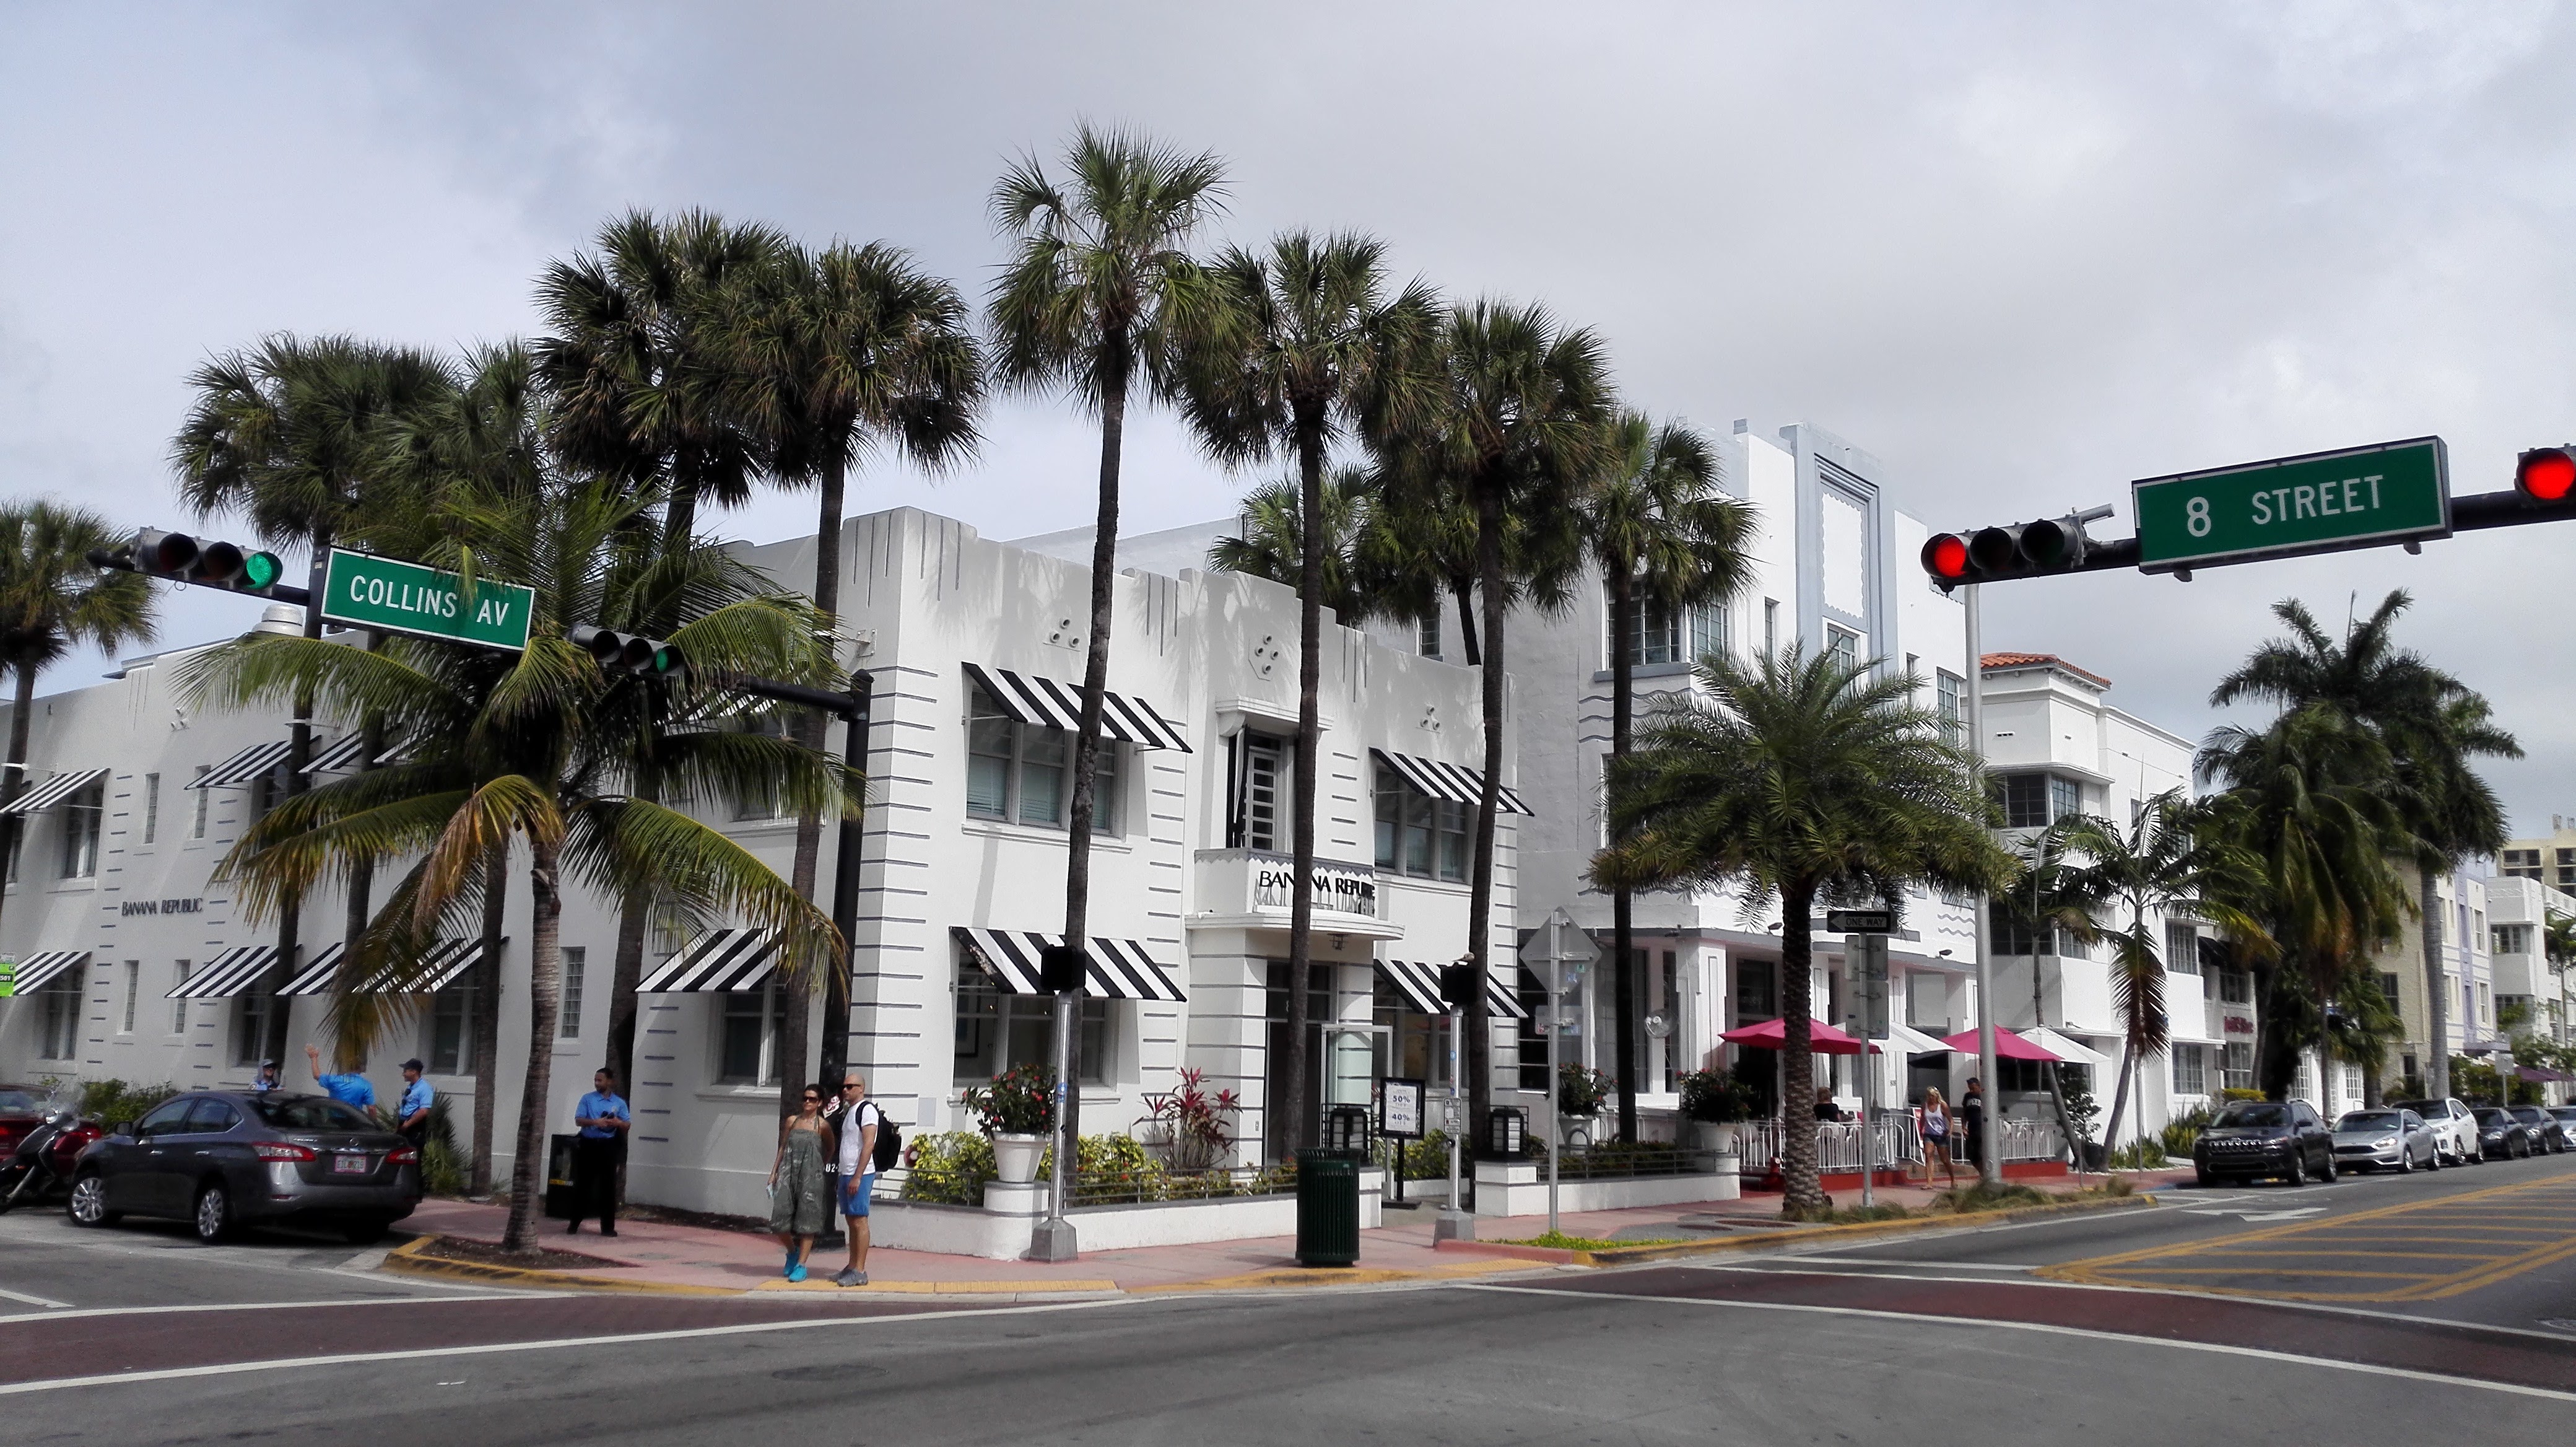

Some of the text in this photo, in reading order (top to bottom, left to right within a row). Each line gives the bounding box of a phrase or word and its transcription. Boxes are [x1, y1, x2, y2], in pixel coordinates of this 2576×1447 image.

[2187, 474, 2383, 537] 8 STREET
[350, 575, 509, 626] COLLINS AV
[1260, 870, 1331, 893] BANNA
[122, 898, 203, 916] BANANA REPUBLIC
[1846, 917, 1884, 927] ONE WAY
[1393, 1095, 1411, 1103] 50%
[825, 1163, 838, 1173] 82
